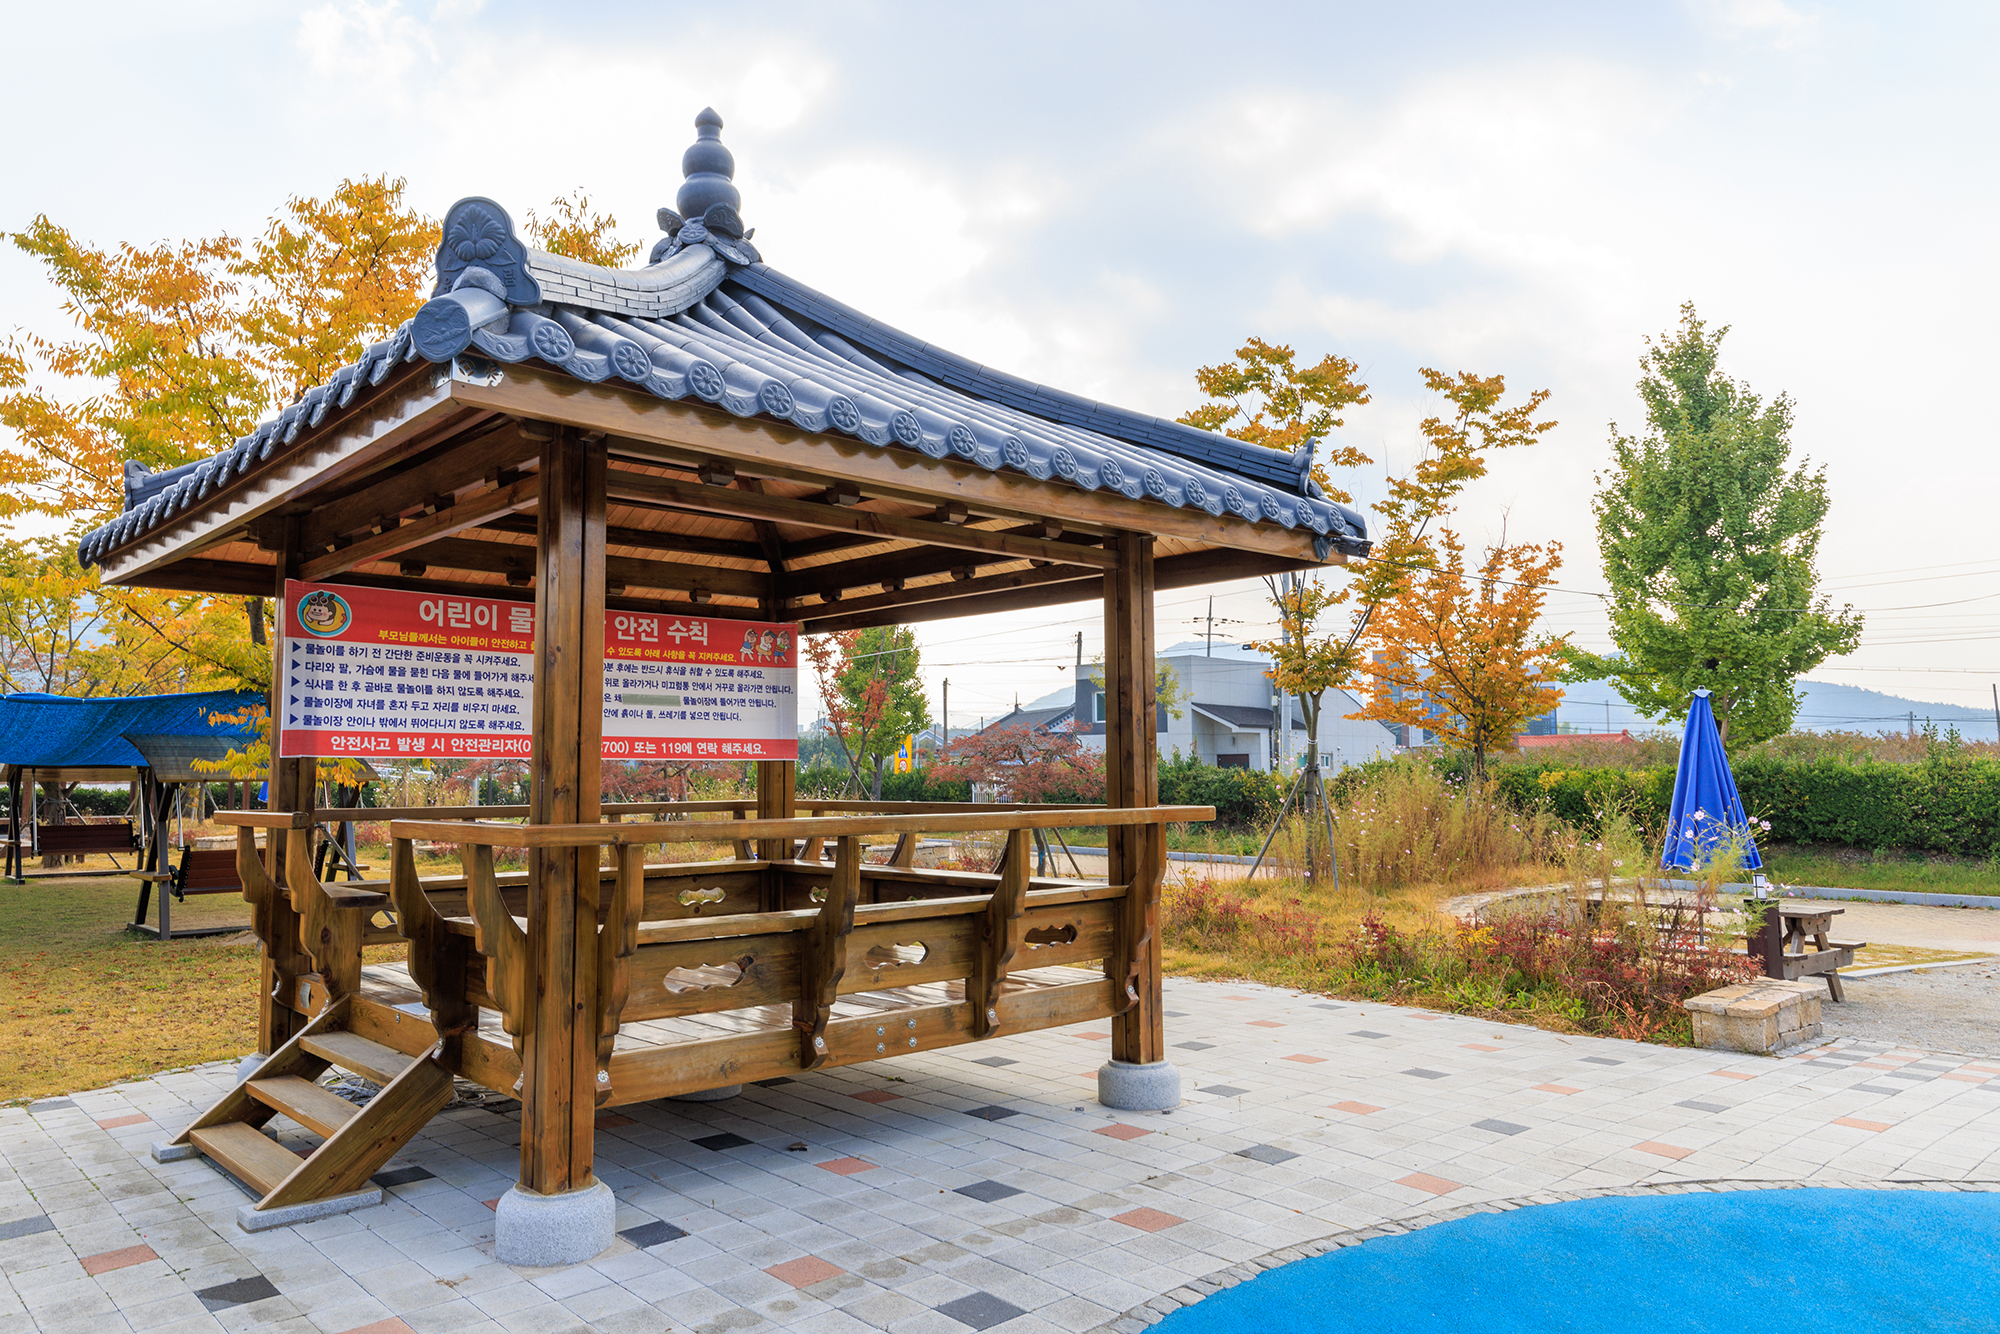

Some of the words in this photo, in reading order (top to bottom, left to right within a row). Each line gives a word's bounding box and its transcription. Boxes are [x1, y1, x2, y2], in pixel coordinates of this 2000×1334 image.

[419, 600, 498, 632] 어린이
[508, 606, 535, 634] 물
[614, 616, 659, 642] 안전
[667, 620, 708, 646] 수칙
[305, 643, 345, 657] 물놀이를
[348, 646, 368, 658] 하기
[372, 648, 382, 659] 전
[385, 649, 413, 661] 간단한
[416, 650, 461, 664] 준비운동을
[464, 654, 473, 665] 꼭
[476, 655, 521, 668] 시켜주세요.
[378, 629, 447, 645] 부모님들께서는
[450, 635, 488, 647] 아이들이
[491, 638, 527, 650] 안전하고
[606, 646, 615, 656] 수
[618, 647, 642, 658] 있도록
[644, 648, 660, 659] 아래
[663, 650, 686, 660] 사항을
[688, 651, 696, 661] 꼭
[698, 652, 737, 663] 지켜주세요.
[305, 661, 335, 674] 다리와
[356, 664, 385, 676] 가슴에
[388, 666, 407, 678] 물을
[410, 667, 428, 679] 묻힌
[432, 668, 450, 680] 다음
[453, 670, 471, 681] 물에
[474, 671, 508, 683] 들어가게
[511, 673, 534, 684] 해주세
[616, 663, 639, 674] 후에는
[641, 664, 663, 675] 반드시
[665, 666, 687, 676] 휴식을
[689, 667, 703, 677] 취할
[705, 668, 712, 677] 수
[715, 668, 735, 678] 있도록
[737, 669, 765, 680] 해주세요.
[304, 679, 334, 691] 식사를
[338, 680, 348, 692] 한
[351, 681, 361, 692] 후
[364, 682, 394, 693] 곧바로
[397, 683, 433, 695] 물놀이를
[436, 685, 455, 696] 하지
[458, 686, 484, 697] 않도록
[487, 687, 524, 699] 해주세요.
[604, 677, 620, 688] 위로
[622, 678, 659, 689] 올라가거나
[692, 682, 713, 692] 안에서
[715, 683, 735, 692] 거꾸로
[737, 683, 763, 694] 올라가면
[765, 685, 794, 695] 안됩니다.
[304, 696, 353, 709] 물놀이장에
[356, 699, 385, 710] 자녀를
[389, 700, 408, 711] 혼자
[411, 701, 429, 712] 두고
[432, 702, 459, 713] 자리를
[462, 702, 489, 714] 비우지
[492, 704, 520, 715] 마세요.
[683, 696, 718, 707] 물놀이장에
[720, 697, 747, 708] 들어가면
[748, 698, 777, 709] 안됩니다.
[303, 715, 343, 727] 물놀이장
[346, 716, 376, 728] 안이나
[379, 717, 407, 729] 밖에서
[411, 718, 456, 730] 뛰어다니지
[459, 719, 486, 730] 않도록
[488, 720, 525, 731] 해주세요.
[603, 708, 619, 719] 안에
[621, 709, 643, 719] 흙이나
[658, 710, 687, 720] 쓰레기를
[689, 711, 710, 721] 넣으면
[712, 712, 742, 722] 안됩니다.
[331, 736, 391, 752] 안전사고
[397, 737, 425, 752] 발생
[431, 737, 444, 752] 시
[451, 738, 532, 754] 안전관리자(0
[601, 740, 630, 755] 700)
[634, 741, 657, 754] 또는
[661, 742, 692, 755] 119에
[696, 742, 718, 755] 연락
[722, 742, 767, 756] 해주세요.
